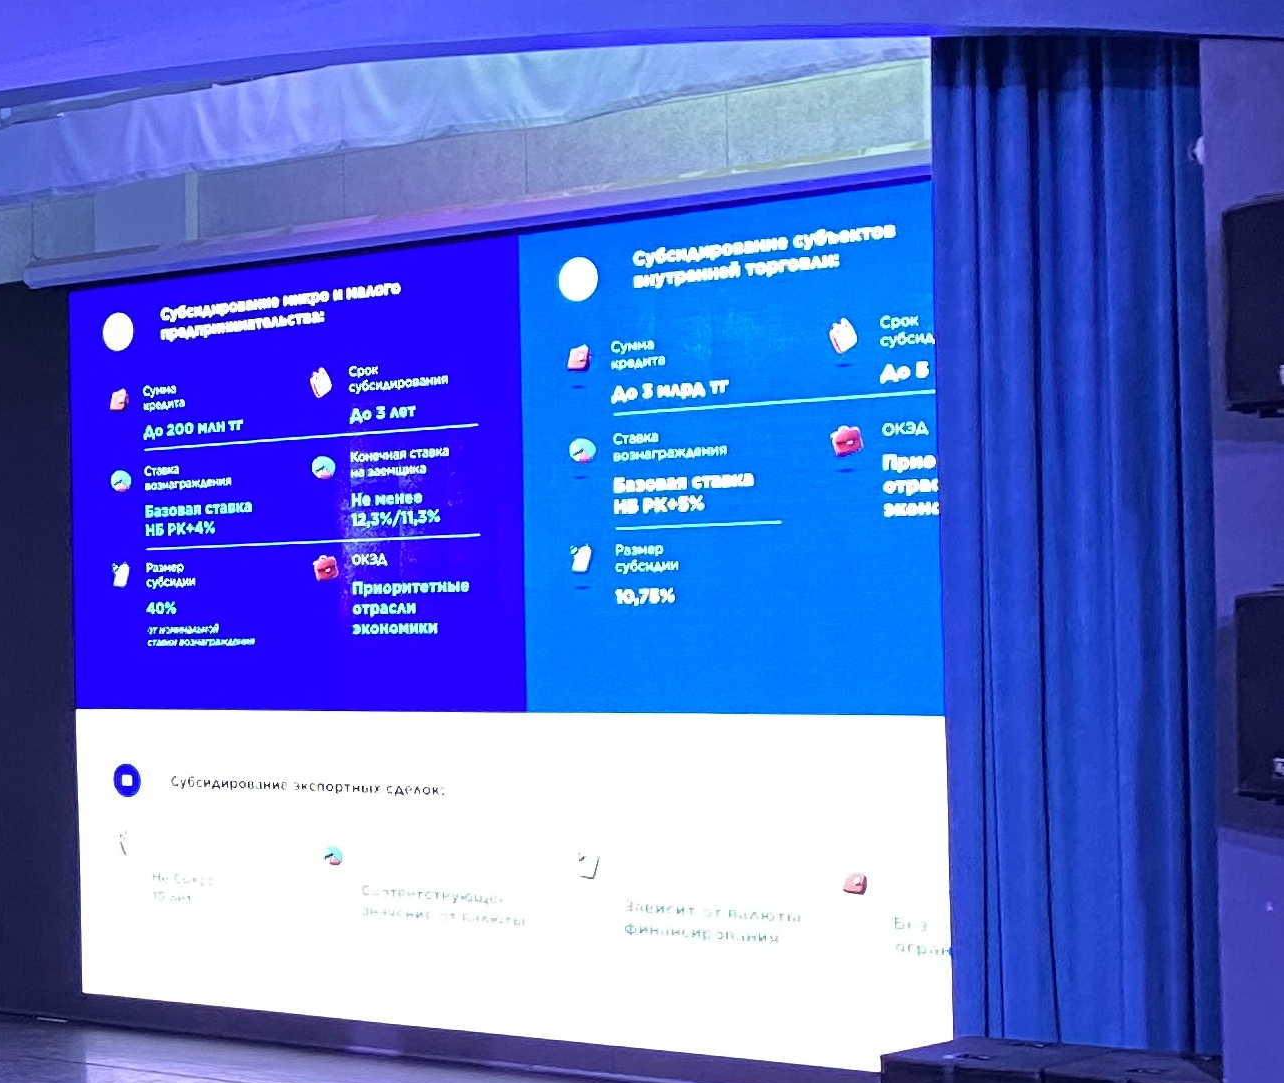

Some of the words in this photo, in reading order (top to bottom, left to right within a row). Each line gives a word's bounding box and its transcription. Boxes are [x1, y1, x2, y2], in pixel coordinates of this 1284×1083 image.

[632, 236, 788, 269] Субсидирование
[792, 224, 897, 251] субъектов
[633, 260, 742, 289] внутренней
[160, 296, 280, 322] Субсидирование
[282, 290, 330, 307] микро
[332, 289, 344, 302] и
[345, 282, 402, 300] малого
[160, 310, 325, 342] предпринимательства:
[879, 314, 920, 330] Срок
[610, 339, 655, 355] Сумма
[610, 355, 666, 371] кредита
[348, 365, 379, 379] Срок
[879, 363, 911, 385] До
[142, 385, 177, 398] Сумма
[348, 374, 449, 395] субсидирования
[610, 385, 639, 405] До
[641, 382, 654, 400] 3
[143, 398, 186, 412] кредита
[349, 407, 372, 425] До
[375, 405, 386, 420] 3
[389, 405, 417, 419] лет
[142, 425, 164, 441] До
[166, 422, 194, 437] 200
[881, 420, 930, 437] ОКЭД
[613, 432, 659, 445] Ставка
[350, 450, 407, 463] Конечная
[409, 447, 450, 459] ставка
[613, 445, 728, 463] вознаграждения
[143, 465, 180, 477] Ставка
[350, 468, 365, 479] на
[144, 476, 232, 491] вознаграждения
[613, 476, 688, 494] Базовая
[691, 472, 755, 490] ставка
[351, 492, 371, 507] Не
[374, 492, 423, 506] менее
[613, 498, 639, 515] НБ
[642, 495, 705, 515] РК+5%
[144, 504, 202, 519] Базовая
[204, 501, 253, 515] ставка
[351, 508, 441, 529] 12,3%/11,3%
[145, 523, 165, 537] НБ
[167, 520, 216, 537] РК+4%
[615, 543, 664, 557] Размер
[351, 552, 388, 567] ОКЭД
[615, 558, 679, 575] субсидии
[145, 562, 185, 574] Размер
[145, 575, 196, 590] субсидии
[352, 580, 470, 598] Приоритетные
[145, 601, 177, 615] 40%
[352, 602, 417, 618] отрасли
[352, 622, 438, 635] экономики
[170, 775, 288, 791] Субсидирование
[293, 781, 381, 794] экспортных
